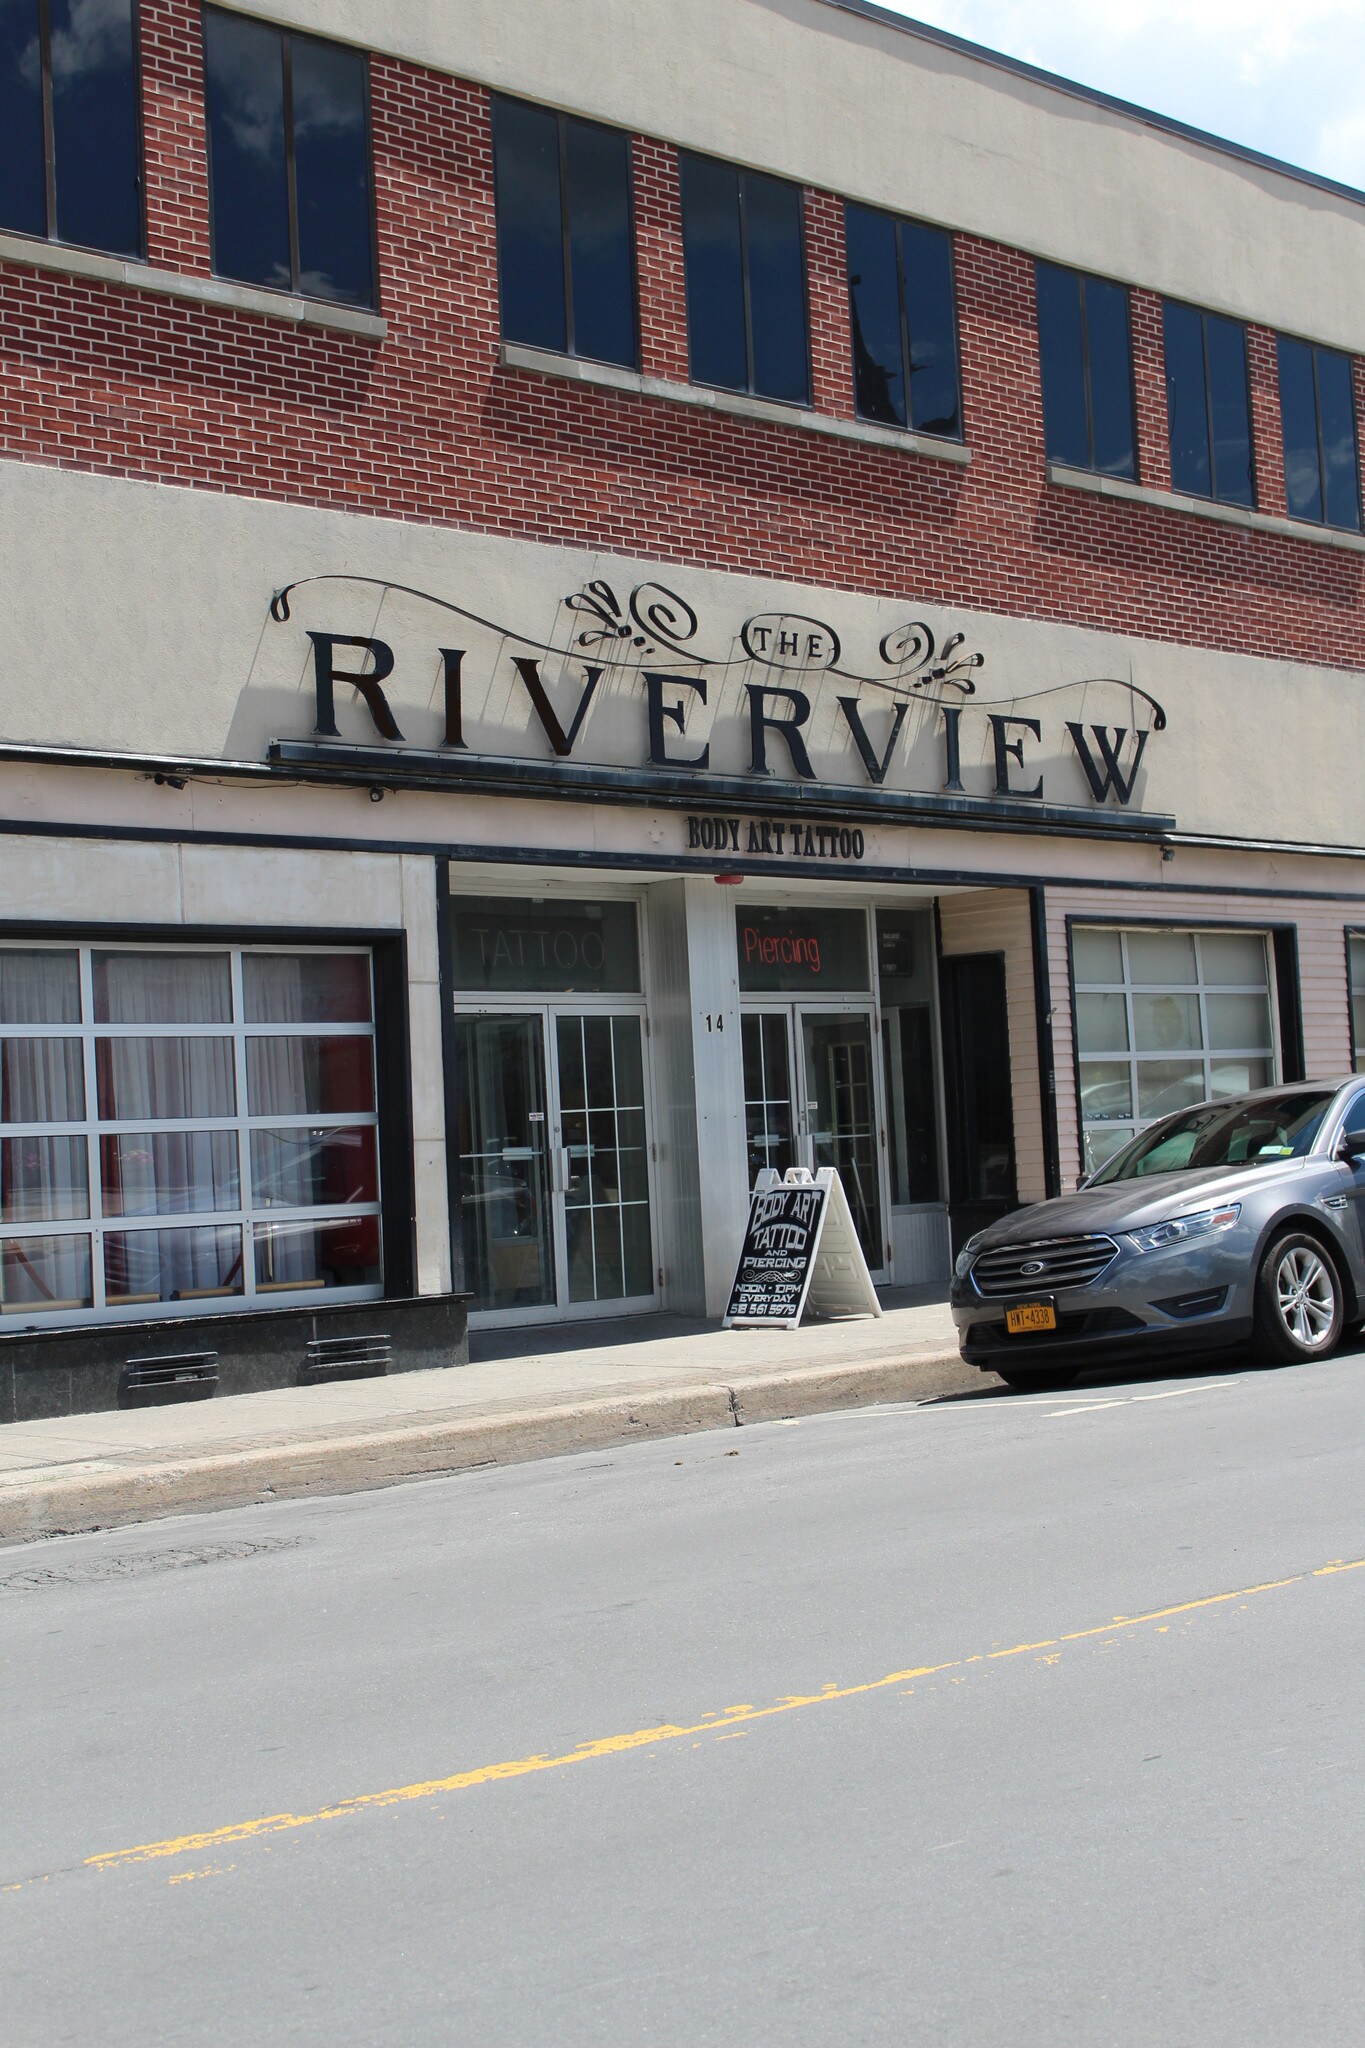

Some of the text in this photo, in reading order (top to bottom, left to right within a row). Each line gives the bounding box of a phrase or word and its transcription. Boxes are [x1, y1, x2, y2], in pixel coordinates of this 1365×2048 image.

[754, 627, 823, 659] THE
[305, 631, 1150, 805] RIVERVIEW
[688, 816, 864, 859] BODY ART TATTOO
[466, 928, 605, 970] TATTOO
[744, 928, 820, 972] Piercing
[706, 1014, 724, 1032] 14
[750, 1191, 821, 1235] BODY ART
[753, 1223, 807, 1250] TATTOO
[743, 1257, 807, 1269] PIERCING
[765, 1249, 788, 1257] AND
[734, 1283, 766, 1293] NOON
[774, 1284, 802, 1294] 10PM
[739, 1293, 795, 1303] EVERYDAY
[729, 1303, 797, 1315] 518 561 5979
